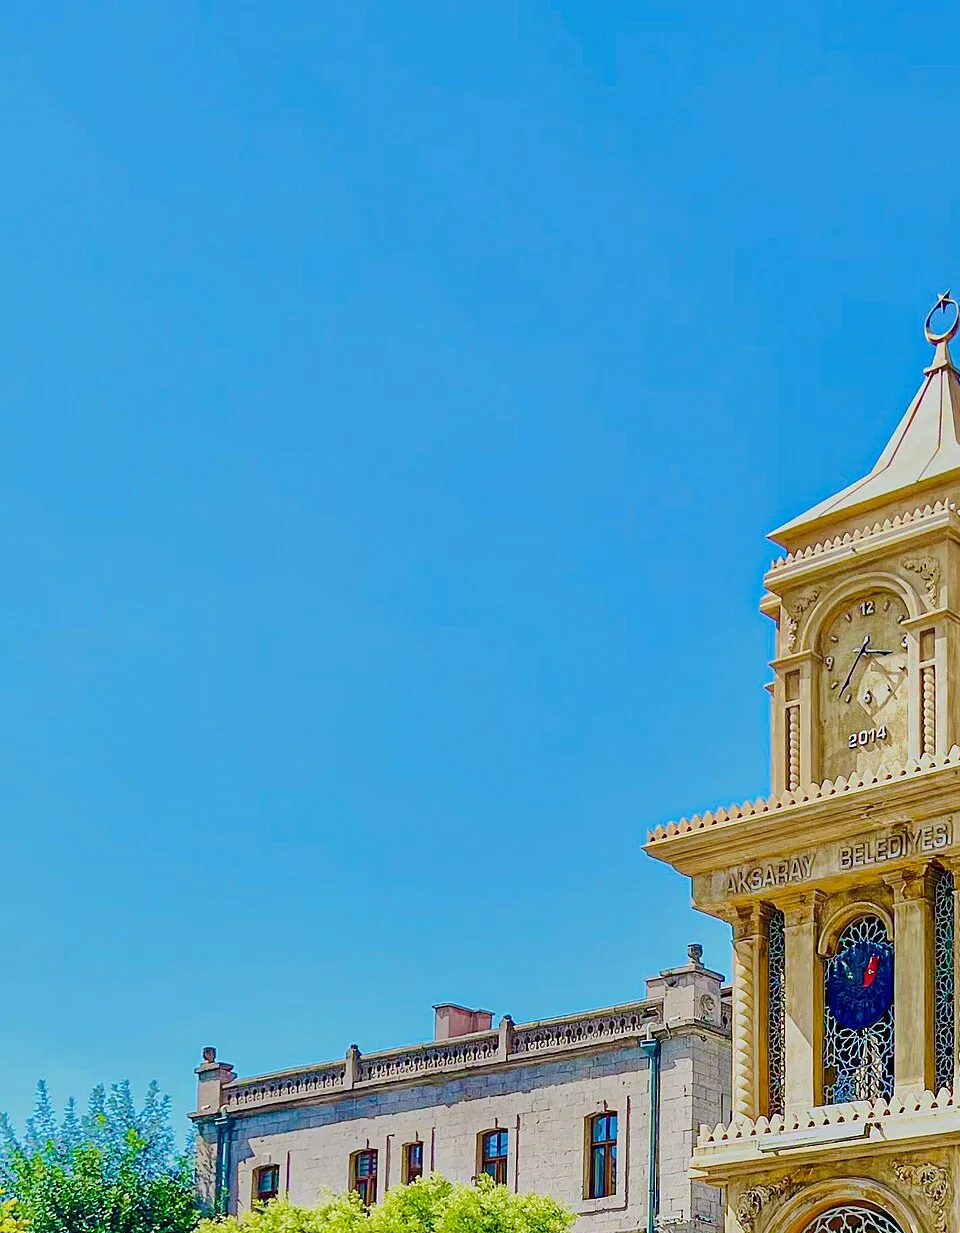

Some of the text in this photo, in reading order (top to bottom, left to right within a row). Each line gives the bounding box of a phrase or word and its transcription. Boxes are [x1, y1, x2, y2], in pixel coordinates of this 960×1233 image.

[860, 601, 875, 616] 12
[825, 656, 834, 671] 9
[848, 725, 887, 749] 2014
[727, 816, 954, 894] AKSARAY BELEDİYESİ
